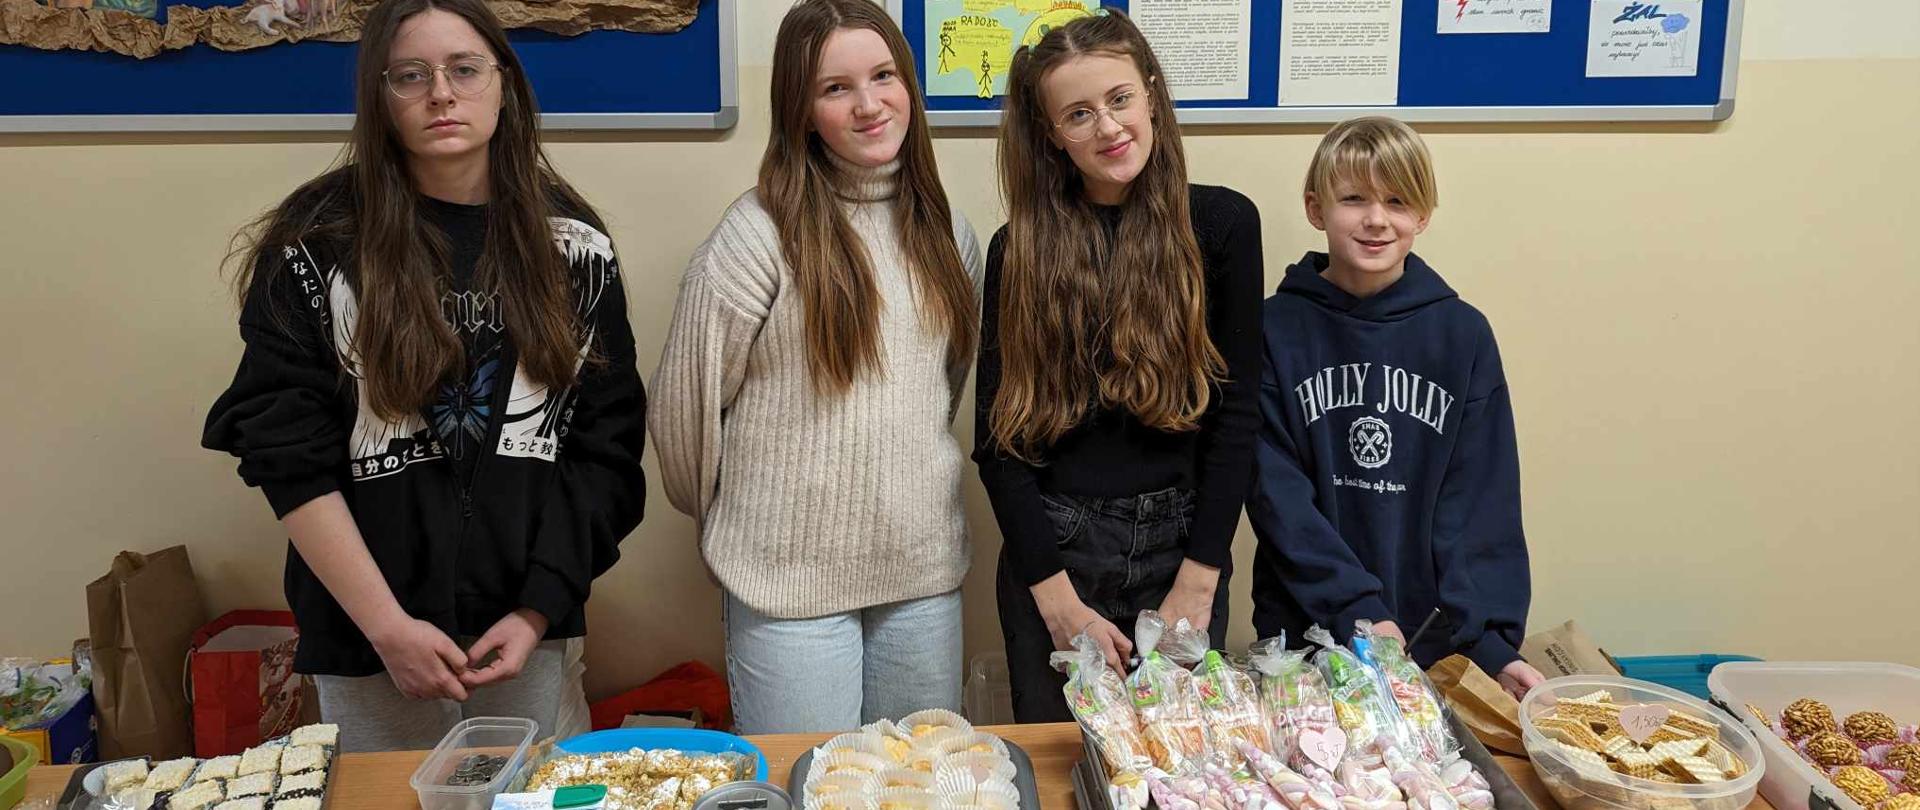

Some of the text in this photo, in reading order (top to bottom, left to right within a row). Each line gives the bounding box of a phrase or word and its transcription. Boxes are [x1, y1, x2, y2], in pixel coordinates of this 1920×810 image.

[1613, 1, 1667, 24] ŻAL
[1295, 362, 1455, 435] HOLLY JOLLY
[1373, 479, 1386, 493] of
